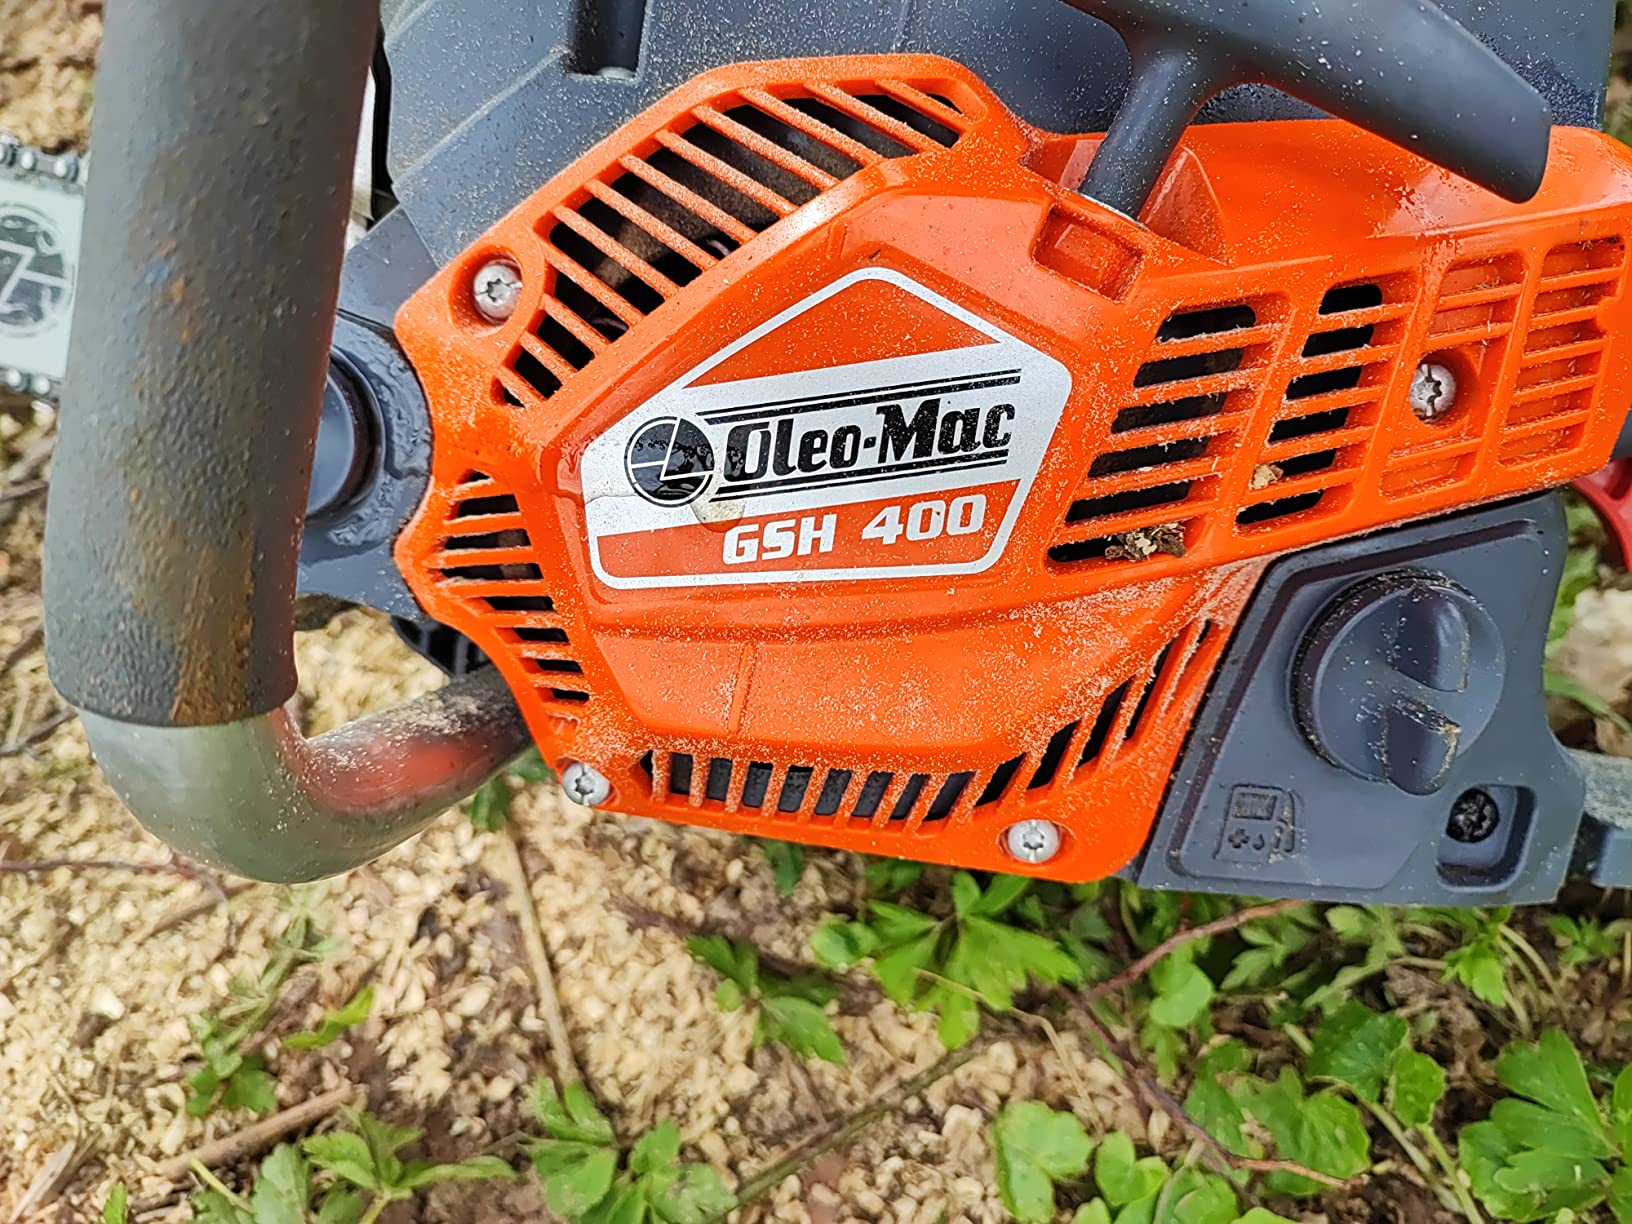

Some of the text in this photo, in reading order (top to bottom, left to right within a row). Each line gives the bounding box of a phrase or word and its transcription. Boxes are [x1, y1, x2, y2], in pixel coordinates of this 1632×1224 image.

[725, 398, 1016, 482] Oleo-Mac
[723, 494, 987, 565] GSH 400
